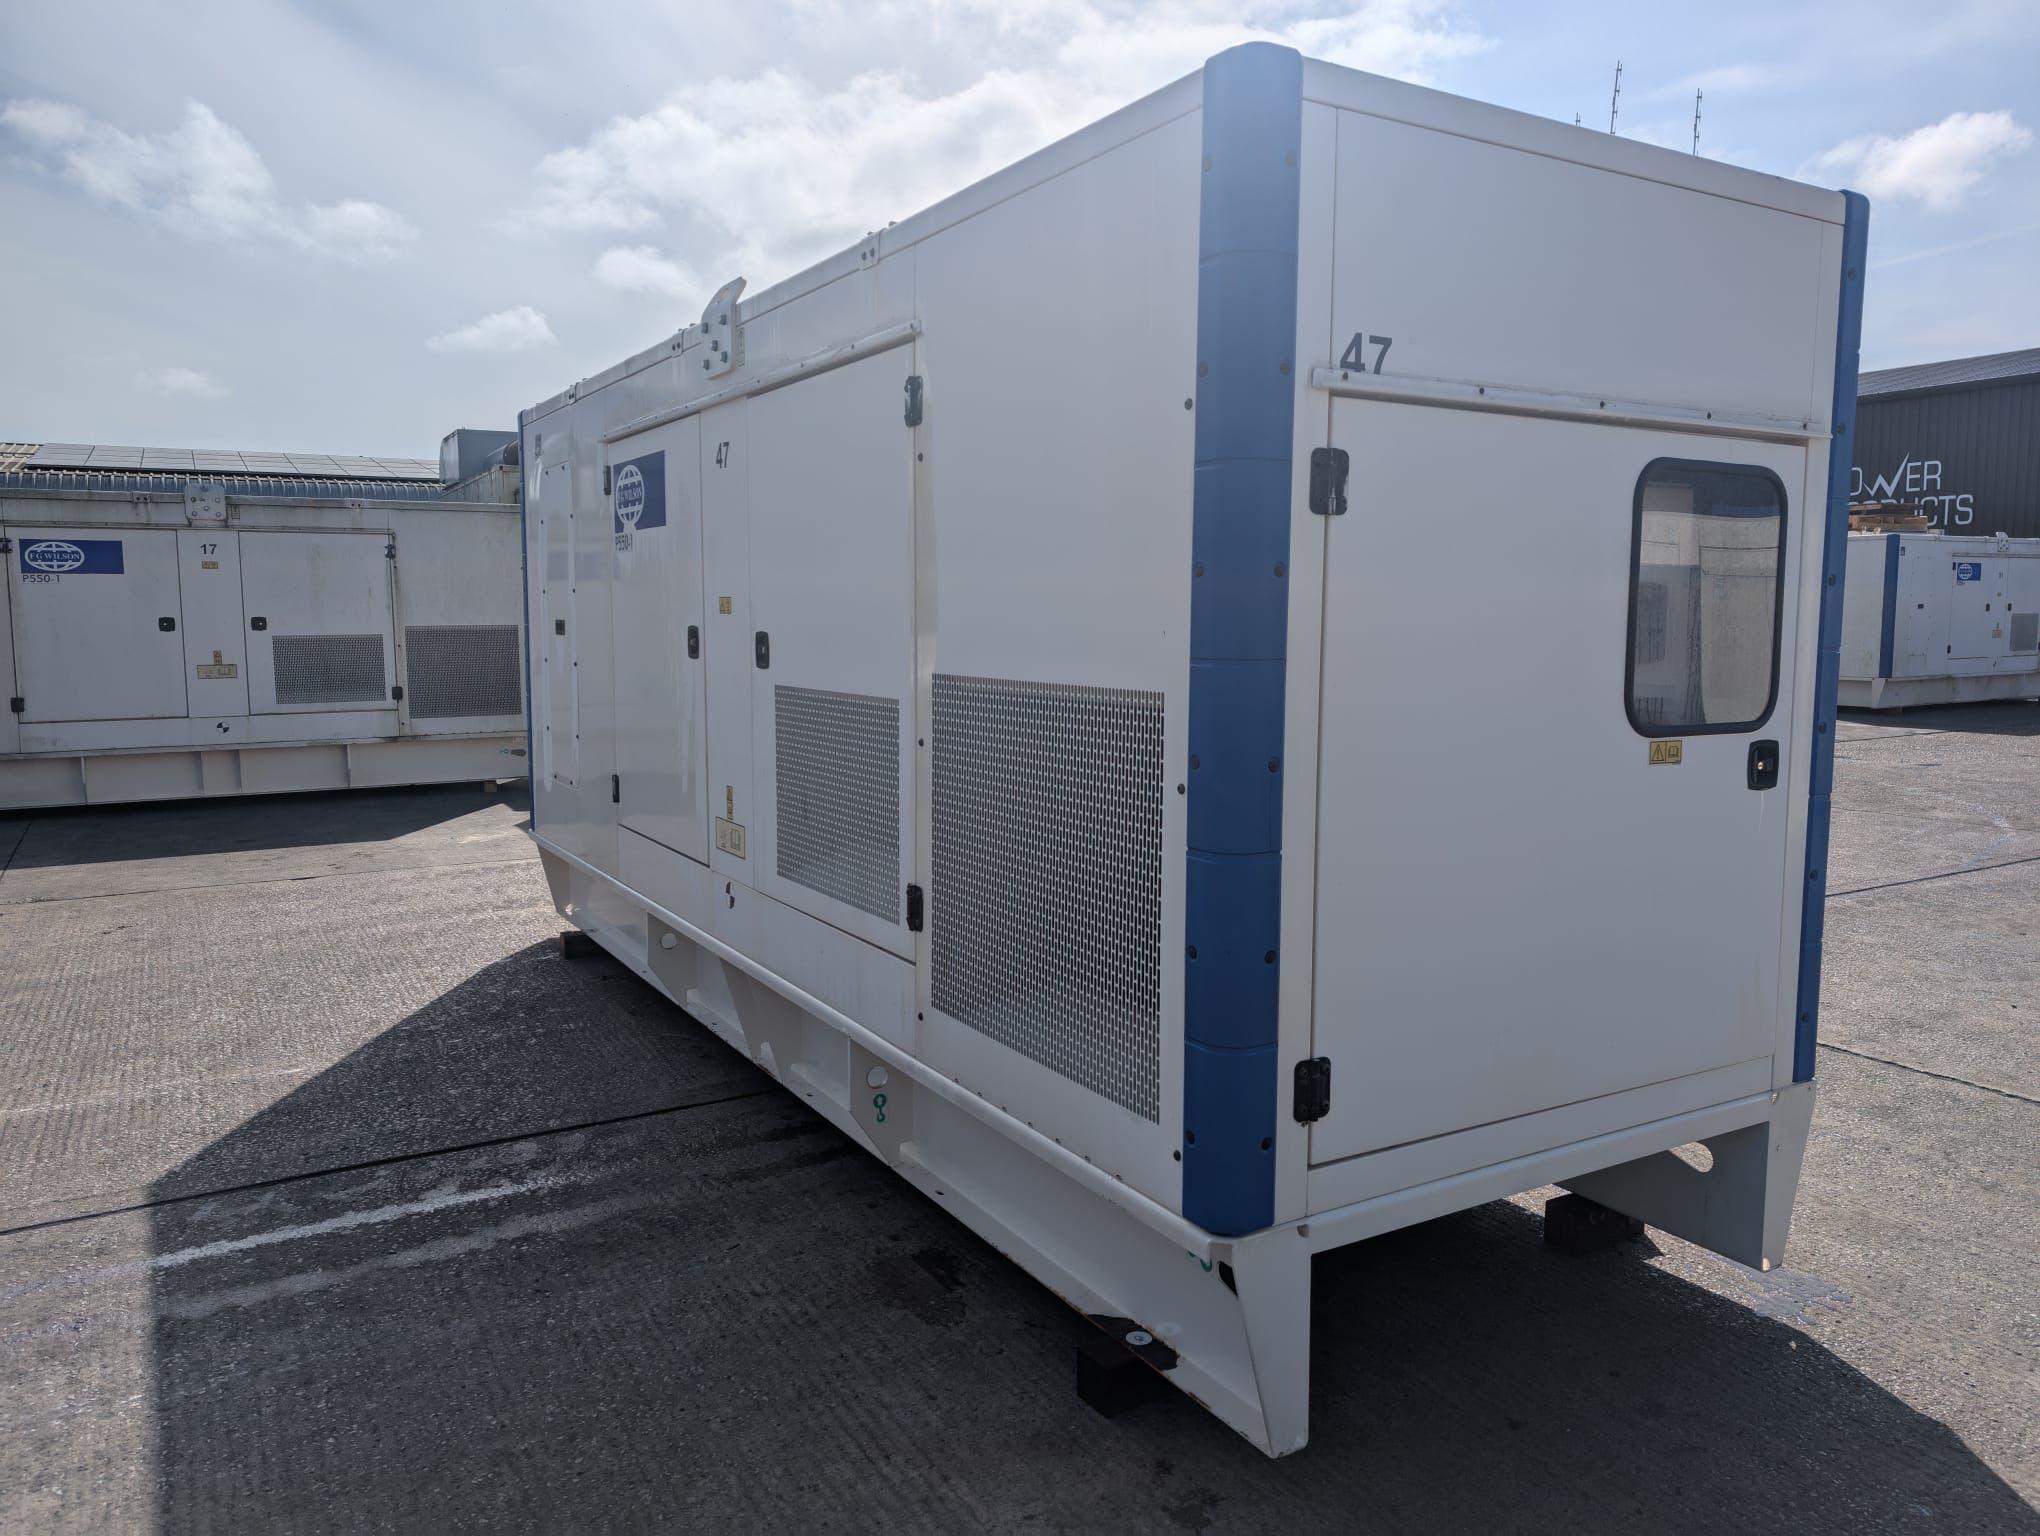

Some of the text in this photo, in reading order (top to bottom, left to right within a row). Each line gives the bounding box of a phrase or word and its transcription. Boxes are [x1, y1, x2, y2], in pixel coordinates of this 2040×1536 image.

[1340, 331, 1393, 375] 47
[715, 441, 730, 469] 47
[1850, 451, 1942, 498] OWER
[44, 552, 80, 560] WILSON
[200, 543, 218, 555] 17
[22, 574, 60, 583] P550-1
